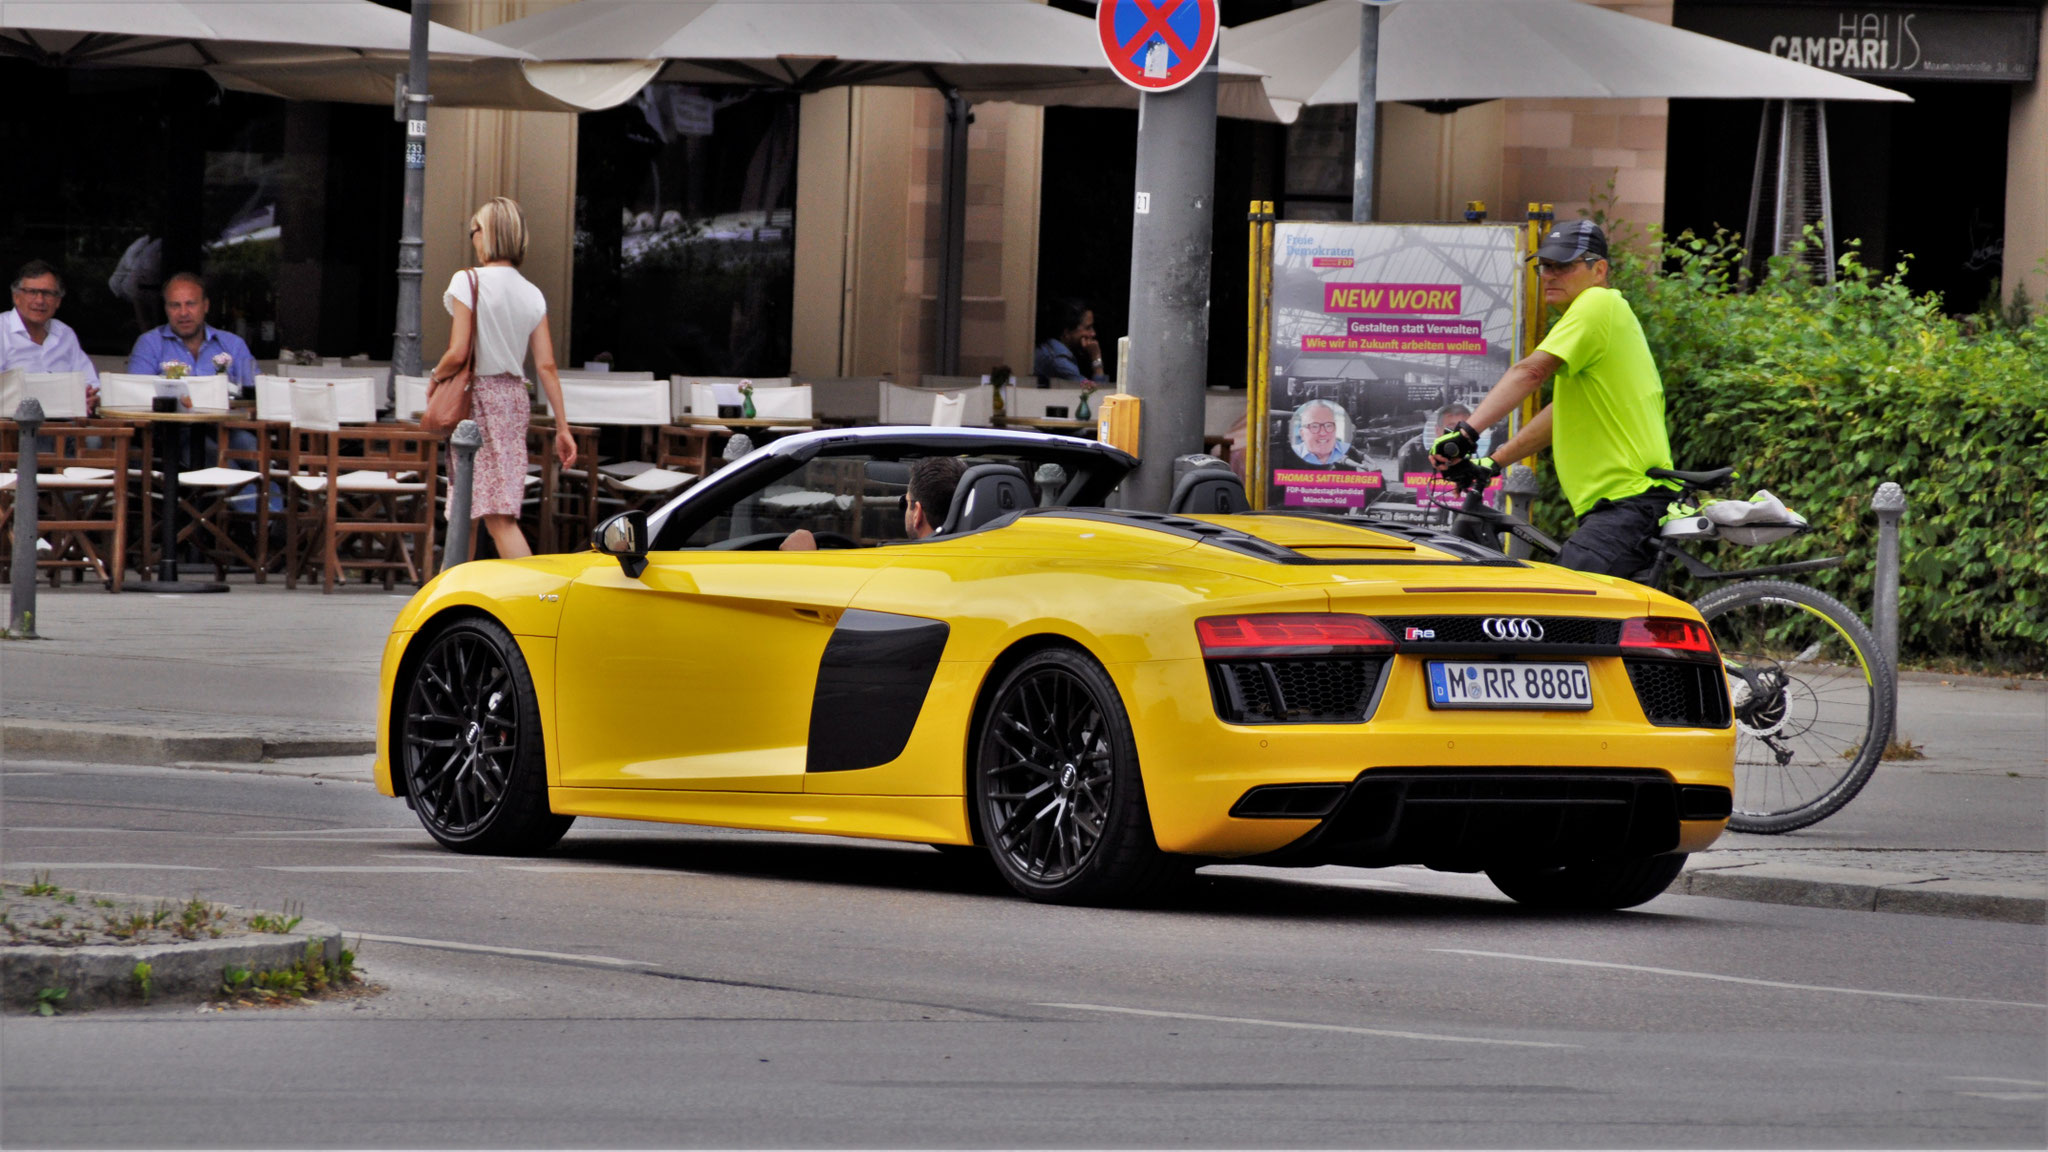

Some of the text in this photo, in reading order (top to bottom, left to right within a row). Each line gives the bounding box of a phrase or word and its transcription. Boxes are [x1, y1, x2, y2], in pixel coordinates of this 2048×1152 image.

[1770, 35, 1889, 70] CAMPARI
[1286, 234, 1314, 245] Freie
[1286, 245, 1354, 256] Demokraten
[1337, 258, 1353, 266] FDP
[1330, 289, 1457, 310] NEW WORK
[1350, 321, 1480, 335] Gestalten statt Verwalten
[1306, 338, 1481, 351] Wie wir in Zukunft arbeiten wollen
[1276, 473, 1379, 485] THOMAS SATTELBERGER
[1303, 496, 1347, 505] München-Süd
[1408, 628, 1435, 639] R8
[1448, 668, 1588, 699] M RR 8880
[1437, 685, 1444, 696] D
